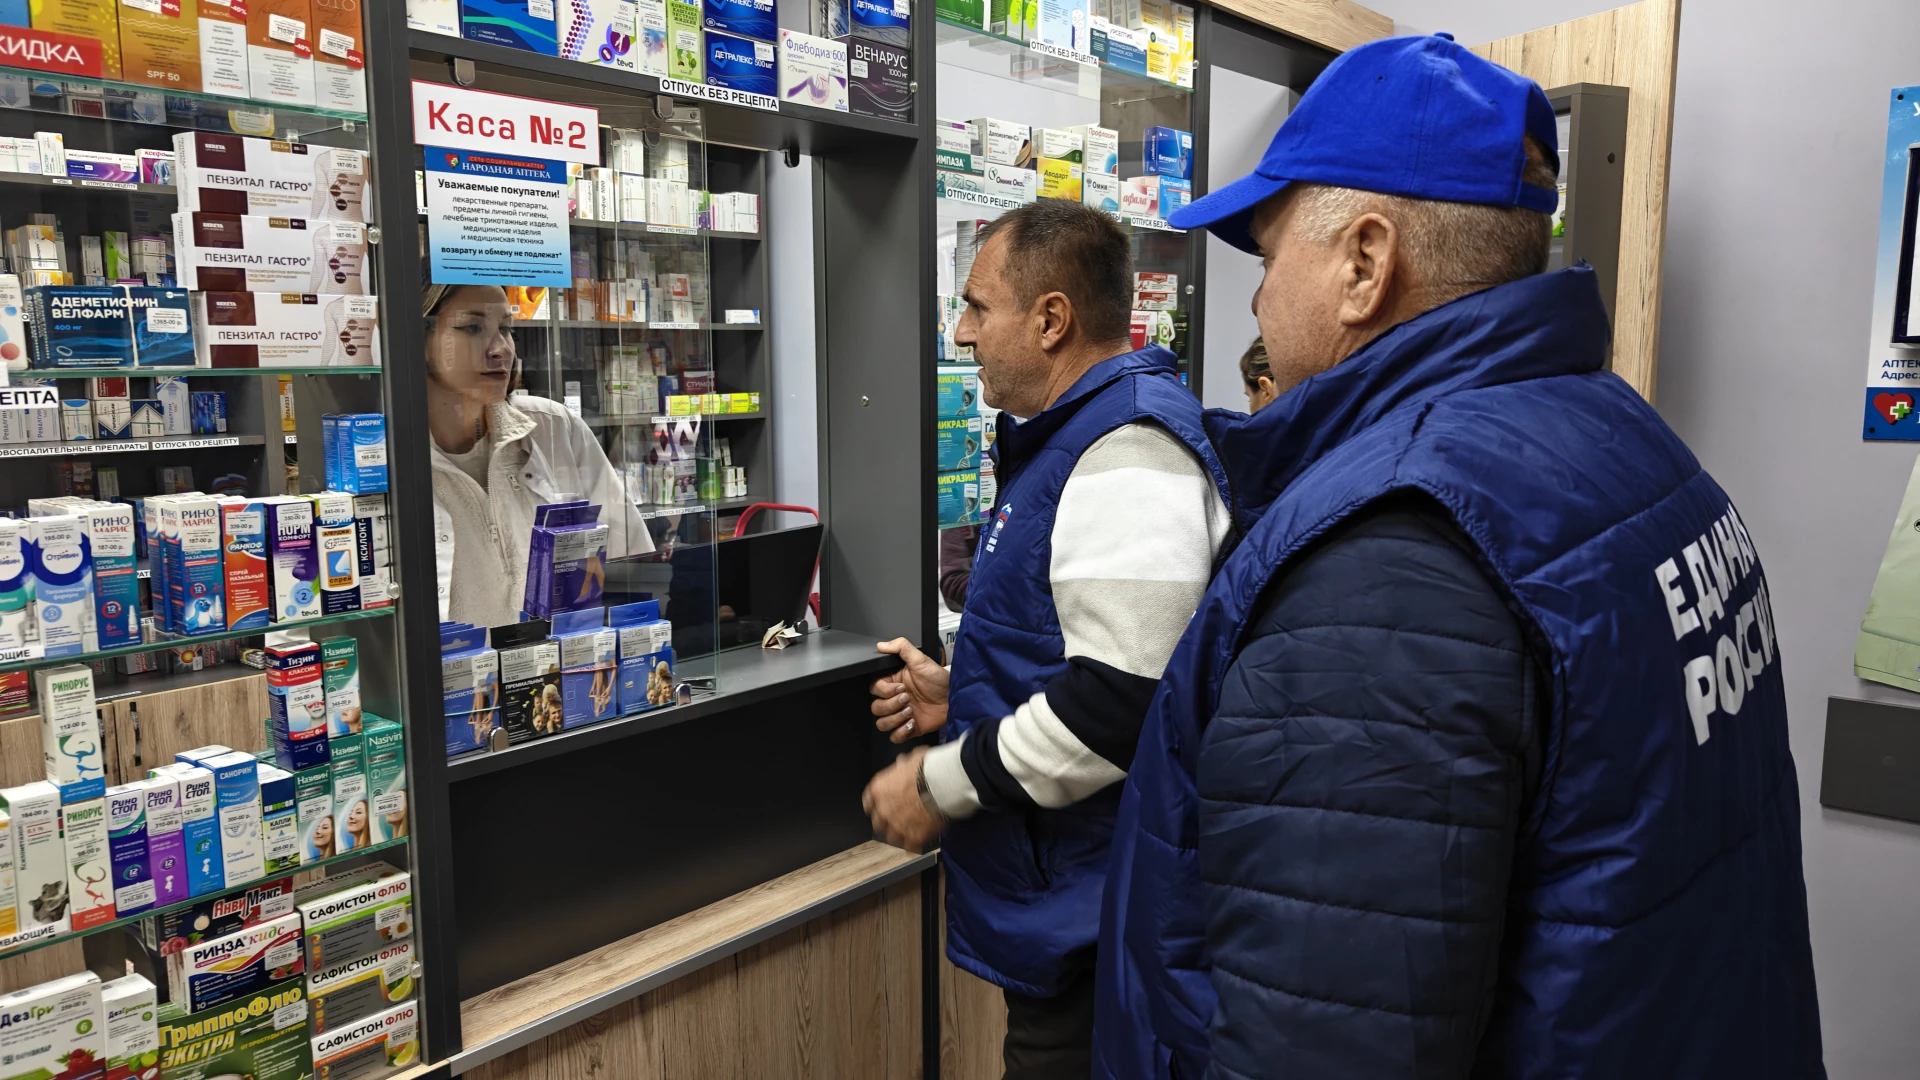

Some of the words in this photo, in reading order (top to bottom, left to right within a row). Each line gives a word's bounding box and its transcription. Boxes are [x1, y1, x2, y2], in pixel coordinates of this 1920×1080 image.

[162, 2, 180, 12] -40%
[231, 4, 247, 15] -40%
[856, 1, 889, 15] ДЕТРАЛЕКС
[294, 43, 311, 53] -40%
[786, 38, 832, 60] Флебодиа
[832, 51, 846, 62] 600
[1031, 40, 1057, 55] ОТПУСК
[1057, 47, 1070, 58] БЕЗ
[1070, 51, 1098, 66] РЕЦЕПТА
[346, 55, 362, 64] -40%
[616, 58, 634, 68] teva
[714, 50, 754, 65] ДЕТРАЛЕКС
[755, 58, 765, 67] 500
[855, 44, 908, 70] ВЕНАРУС
[147, 70, 165, 80] SPF
[168, 73, 181, 82] 50
[888, 68, 901, 78] 1000
[661, 79, 706, 98] ОТПУСК
[708, 87, 728, 100] БЕЗ
[732, 91, 778, 109] РЕЦЕПТА
[428, 100, 516, 141] Каса
[1088, 128, 1116, 140] Профлосин
[336, 161, 352, 169] 187-00
[470, 155, 484, 163] СЕТЬ
[486, 157, 525, 167] СОЦИАЛЬНЫХ
[526, 162, 544, 170] АПТЕК
[462, 162, 513, 175] НАРОДНАЯ
[515, 167, 551, 179] АПТЕКА
[1043, 169, 1068, 180] Аводарт
[207, 174, 264, 188] ПЕНЗИТАЛ
[438, 178, 499, 193] Уважаемые
[501, 185, 560, 199] покупатели!
[452, 196, 508, 208] лекарственные
[509, 200, 549, 211] препараты,
[947, 188, 976, 203] ОТПУСК
[977, 194, 988, 205] ПО
[989, 197, 1021, 210] РЕЦЕПТУ
[1123, 193, 1147, 206] афала
[453, 205, 490, 216] предметы
[491, 208, 517, 217] личной
[518, 211, 549, 220] гигиены,
[443, 213, 479, 223] лечебные
[480, 216, 528, 228] трикотажные
[529, 220, 559, 230] изделия,
[1131, 217, 1152, 227] ОТПУСК
[1152, 221, 1163, 229] БЕЗ
[463, 224, 511, 236] медицинские
[513, 228, 541, 237] изделия
[647, 226, 667, 234] ОТПУСК
[467, 234, 516, 245] медицинская
[517, 236, 544, 246] техника
[204, 252, 263, 265] ПЕНЗИТАЛ
[441, 246, 477, 258] возврату
[484, 248, 512, 259] обмену
[51, 297, 158, 308] АДЕМЕТИОНИН
[52, 308, 124, 319] ВЕЛФАРМ
[218, 331, 275, 341] ПЕНЗИТАЛ
[354, 419, 382, 427] САНОРИН
[95, 443, 147, 451] ПРЕПАРАТЫ
[154, 441, 188, 449] ОТПУСК
[202, 437, 238, 446] РЕЦЕПТУ
[182, 509, 215, 519] РИНО
[93, 516, 130, 527] РИНО
[182, 517, 216, 527] МАРИС
[229, 542, 263, 550] РАНКОФ
[46, 550, 79, 561] Отривин
[230, 573, 265, 581] НАЗАЛЬНЫЙ
[1654, 502, 1755, 642] ЕДИНА
[301, 609, 319, 617] teva
[324, 644, 355, 657] Називин
[511, 650, 528, 661] PLAST
[287, 655, 315, 668] Тизин
[445, 661, 463, 672] PLAST
[288, 665, 317, 676] КЛАССИК
[52, 676, 89, 693] РИНОРУС
[505, 678, 545, 690] ПРЕМИАЛЬНЫЕ
[368, 732, 403, 747] Nasivin
[331, 742, 361, 757] Називин
[220, 766, 253, 780] САНОРИН
[297, 772, 329, 786] Називин
[186, 787, 211, 799] СТОП
[147, 795, 172, 808] СТОП
[66, 805, 103, 822] РИНОРУС
[111, 804, 138, 816] СТОП
[270, 817, 292, 827] КАПЛИ
[308, 891, 377, 921] САФИСТОН
[377, 880, 407, 899] ФЛЮ
[249, 923, 285, 946] кидс
[312, 953, 379, 986] САФИСТОН
[379, 943, 410, 961] ФЛЮ
[158, 987, 302, 1048] ГриппоФлю
[80, 1022, 87, 1031] 6
[317, 1021, 384, 1054] САФИСТОН
[385, 1007, 415, 1027] ФЛЮ
[160, 1030, 236, 1069] ЭКСТРА
